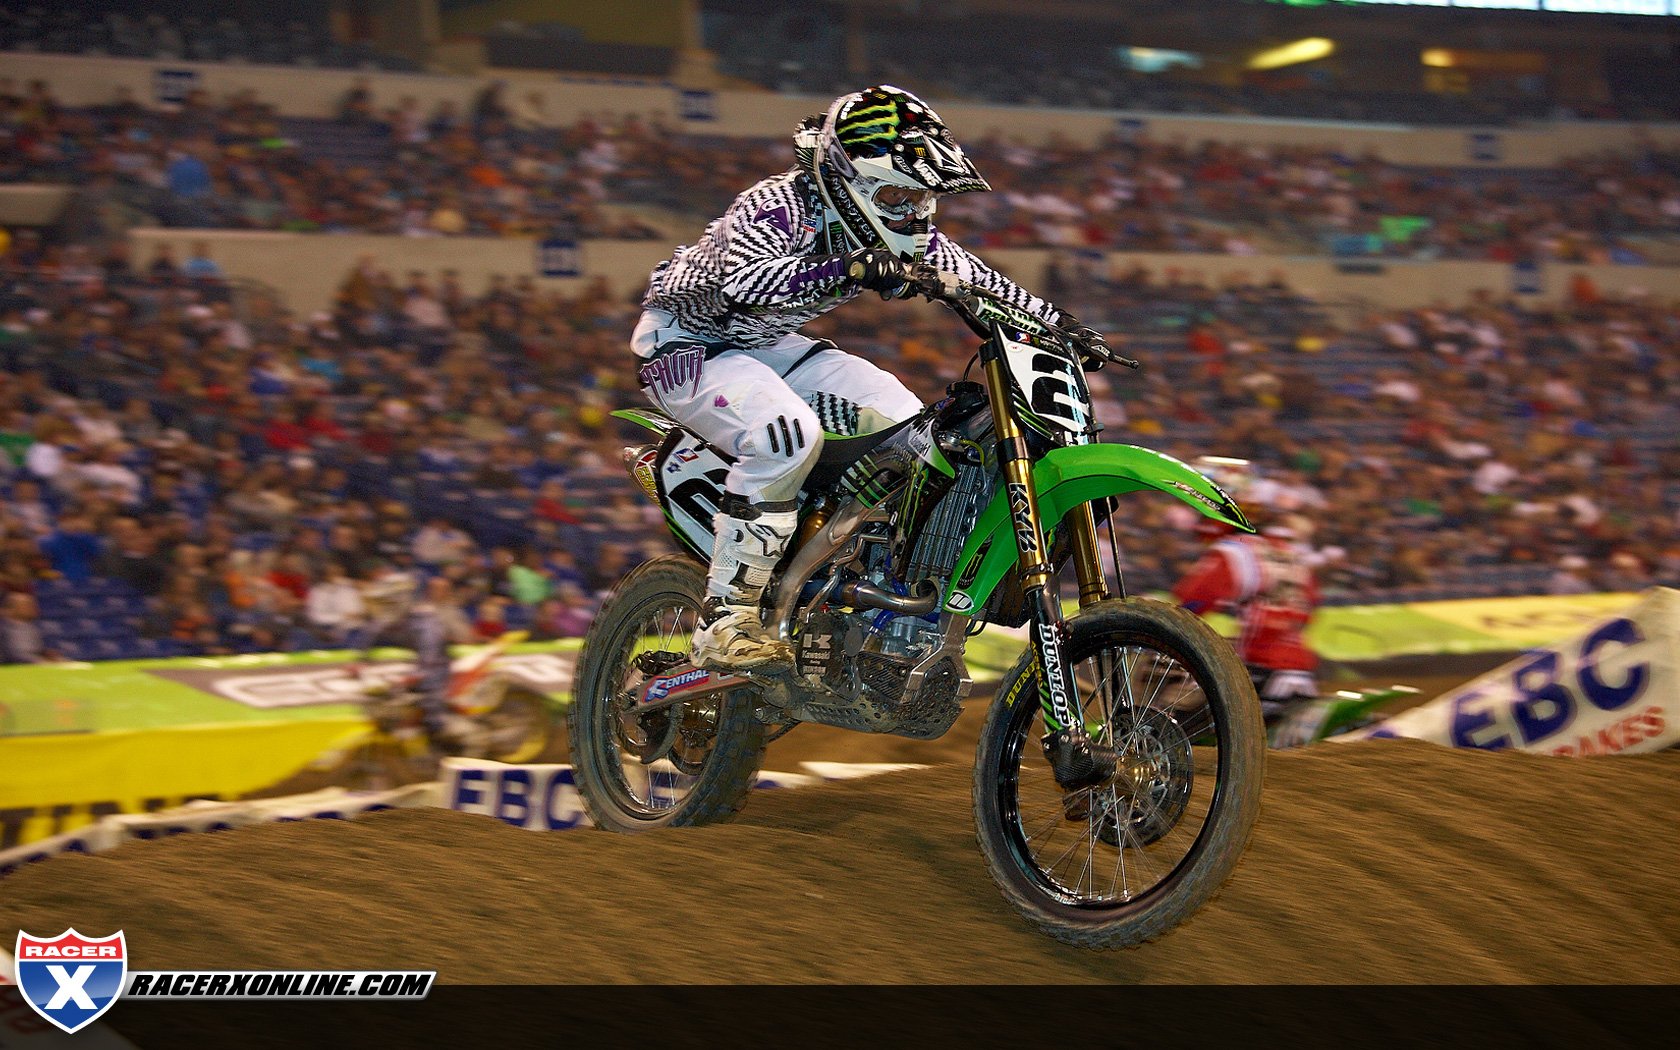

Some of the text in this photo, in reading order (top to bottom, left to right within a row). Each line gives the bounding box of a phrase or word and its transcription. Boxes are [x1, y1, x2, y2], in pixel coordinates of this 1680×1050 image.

[912, 158, 943, 187] VANS
[831, 177, 876, 242] MONSTER
[1008, 483, 1038, 553] KYB
[645, 669, 710, 702] RENTHAL
[1039, 623, 1070, 727] DUNLOP
[1449, 617, 1650, 752] EBC
